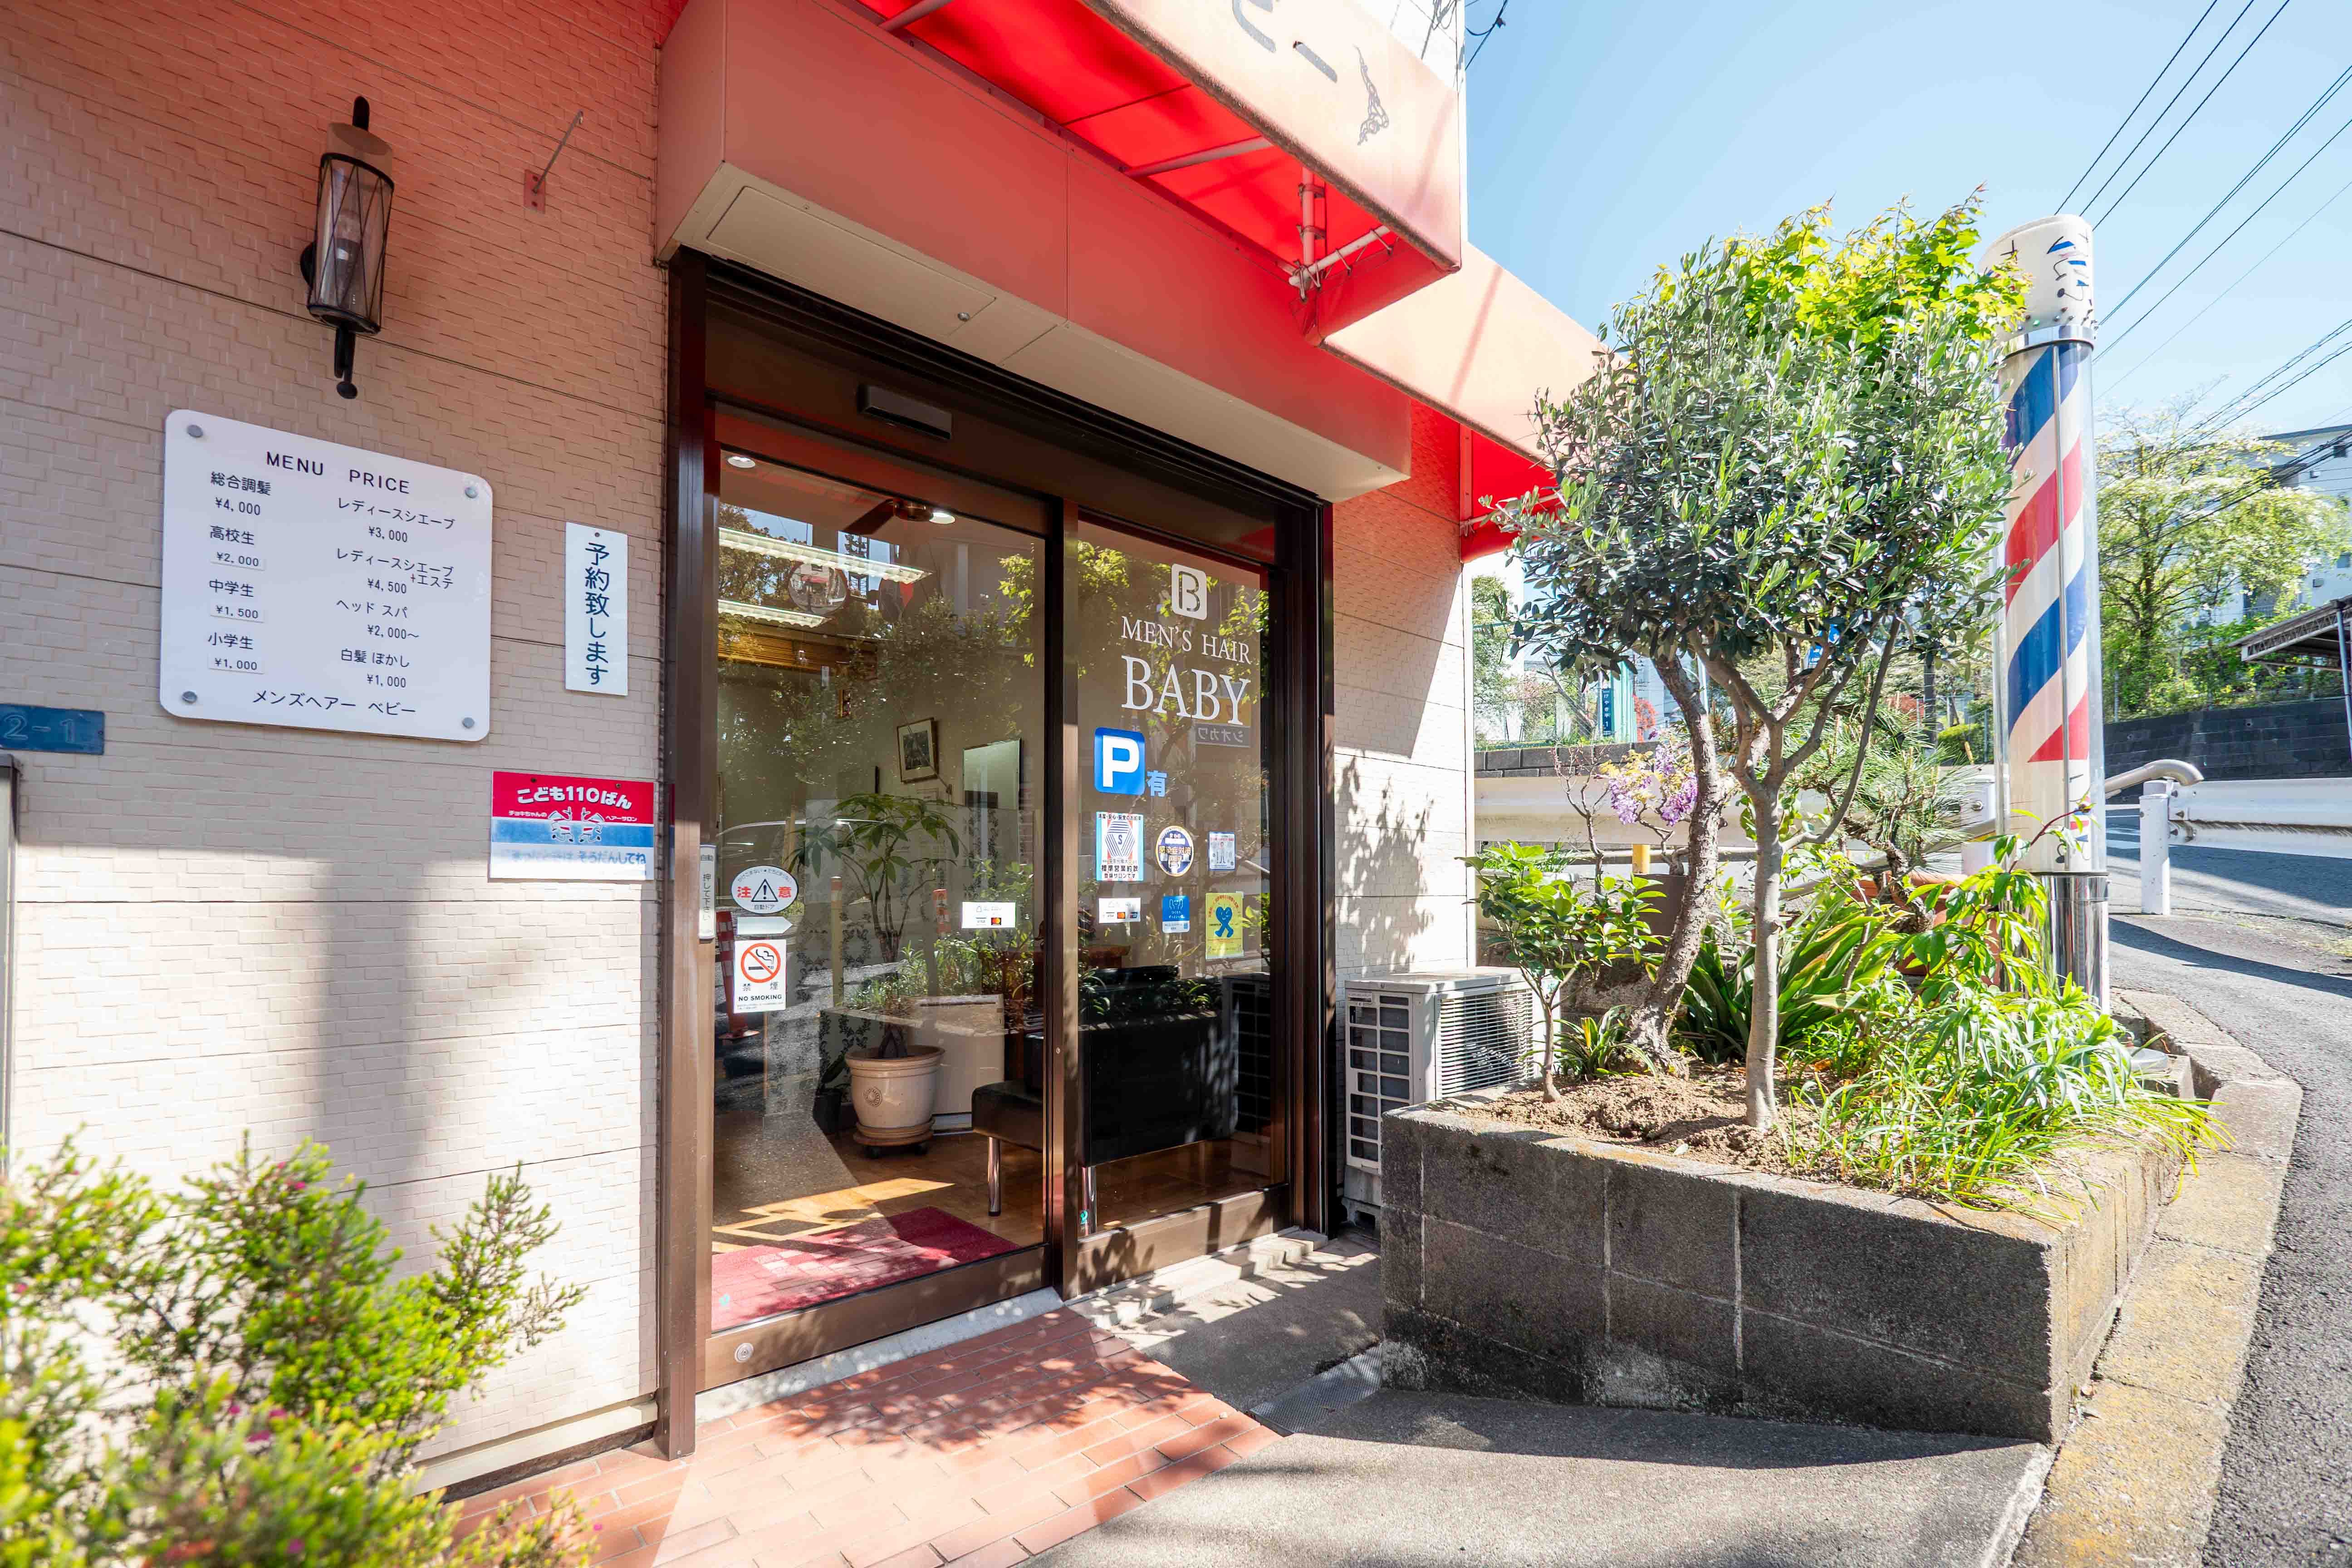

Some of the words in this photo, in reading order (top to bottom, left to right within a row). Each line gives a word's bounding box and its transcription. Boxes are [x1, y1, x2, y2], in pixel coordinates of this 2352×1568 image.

[211, 471, 271, 496] 総合調髪
[267, 451, 324, 476] MENU
[349, 469, 410, 494] PRICE
[216, 497, 261, 516] ¥4,000
[210, 525, 255, 545] 高校生
[369, 526, 408, 543] ¥3,000
[209, 579, 254, 598] 中学生
[368, 578, 407, 593] ¥4,500
[1178, 571, 1201, 612] B
[336, 600, 374, 614] ヘッド
[382, 605, 408, 618] スパ
[585, 542, 610, 685] 予約致します
[208, 632, 253, 650] 小学生
[1121, 616, 1192, 652] MEN'S
[1201, 634, 1251, 665] HAIR
[341, 648, 367, 663] 白髪
[372, 652, 410, 667] ぼかし
[367, 674, 406, 688] ¥1,000
[1122, 655, 1251, 725] BABY
[252, 690, 356, 711] メンズヘアー
[368, 702, 416, 715] ベビー
[1102, 735, 1140, 788] P
[1147, 770, 1167, 797] 有
[517, 786, 632, 810] こども110ばん
